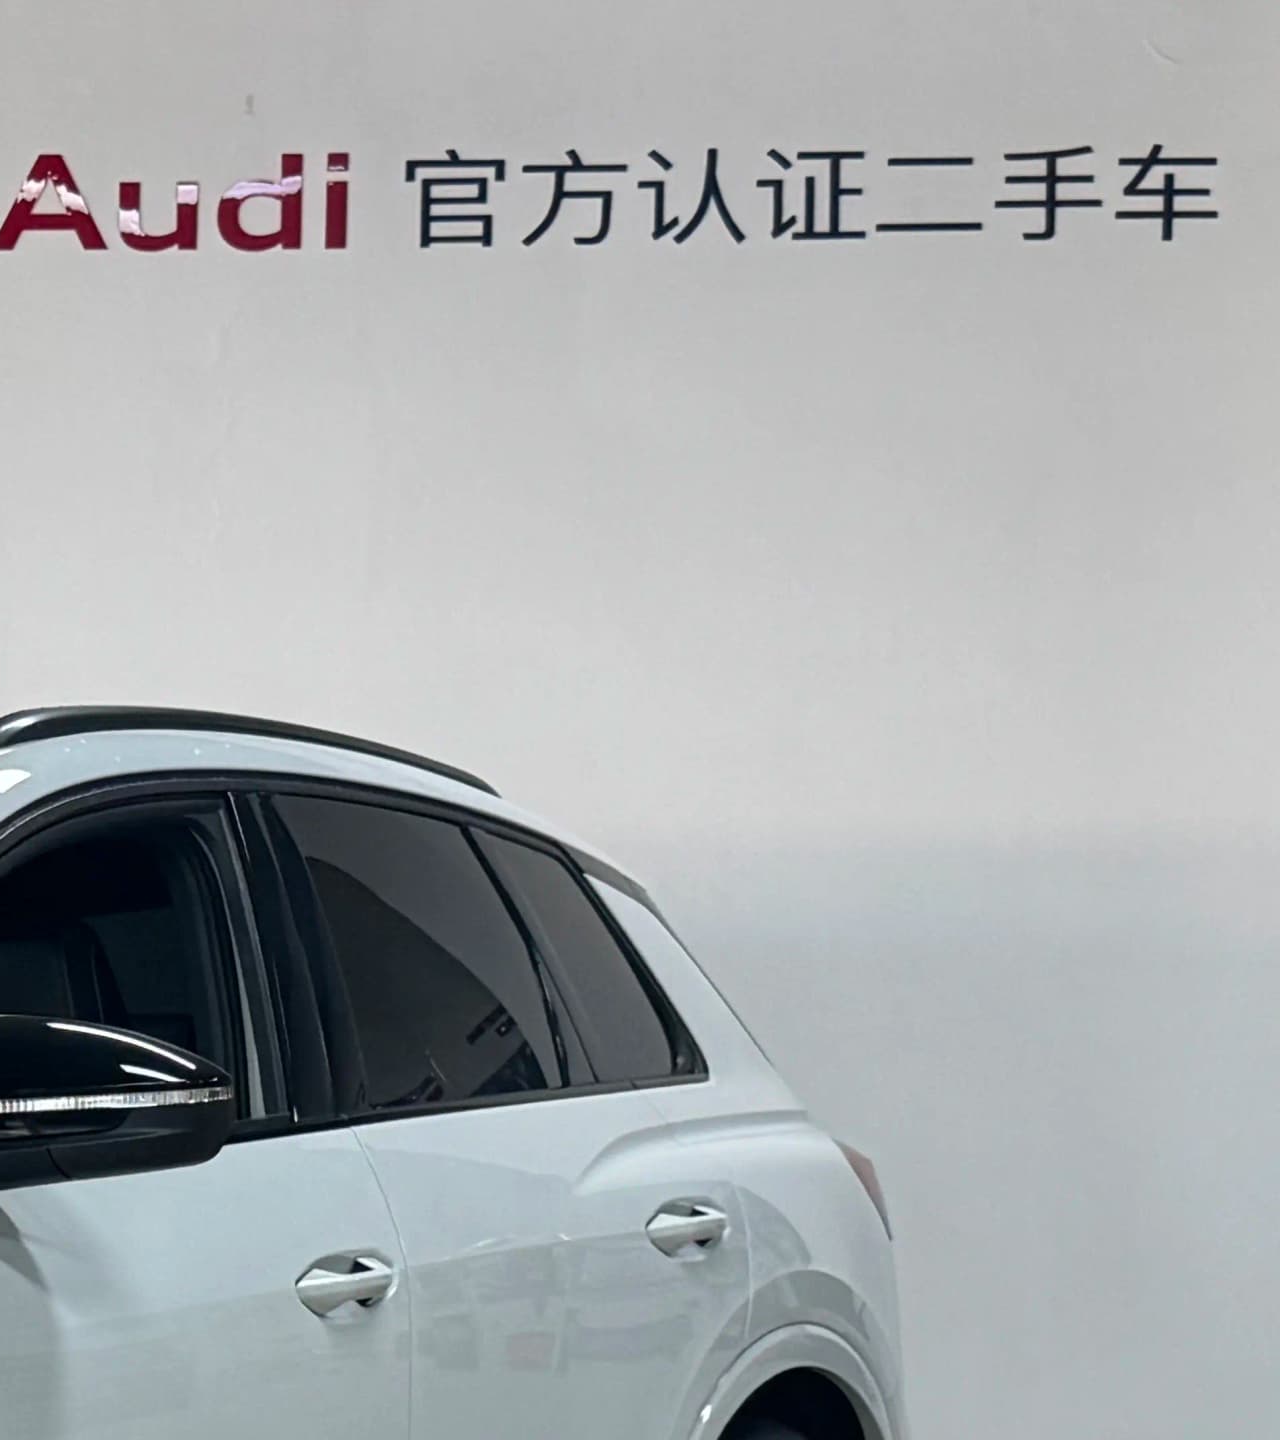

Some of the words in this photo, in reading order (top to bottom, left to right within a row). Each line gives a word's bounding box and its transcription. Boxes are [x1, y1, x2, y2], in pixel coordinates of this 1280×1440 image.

[404, 143, 1220, 249] 官方认证二手车
